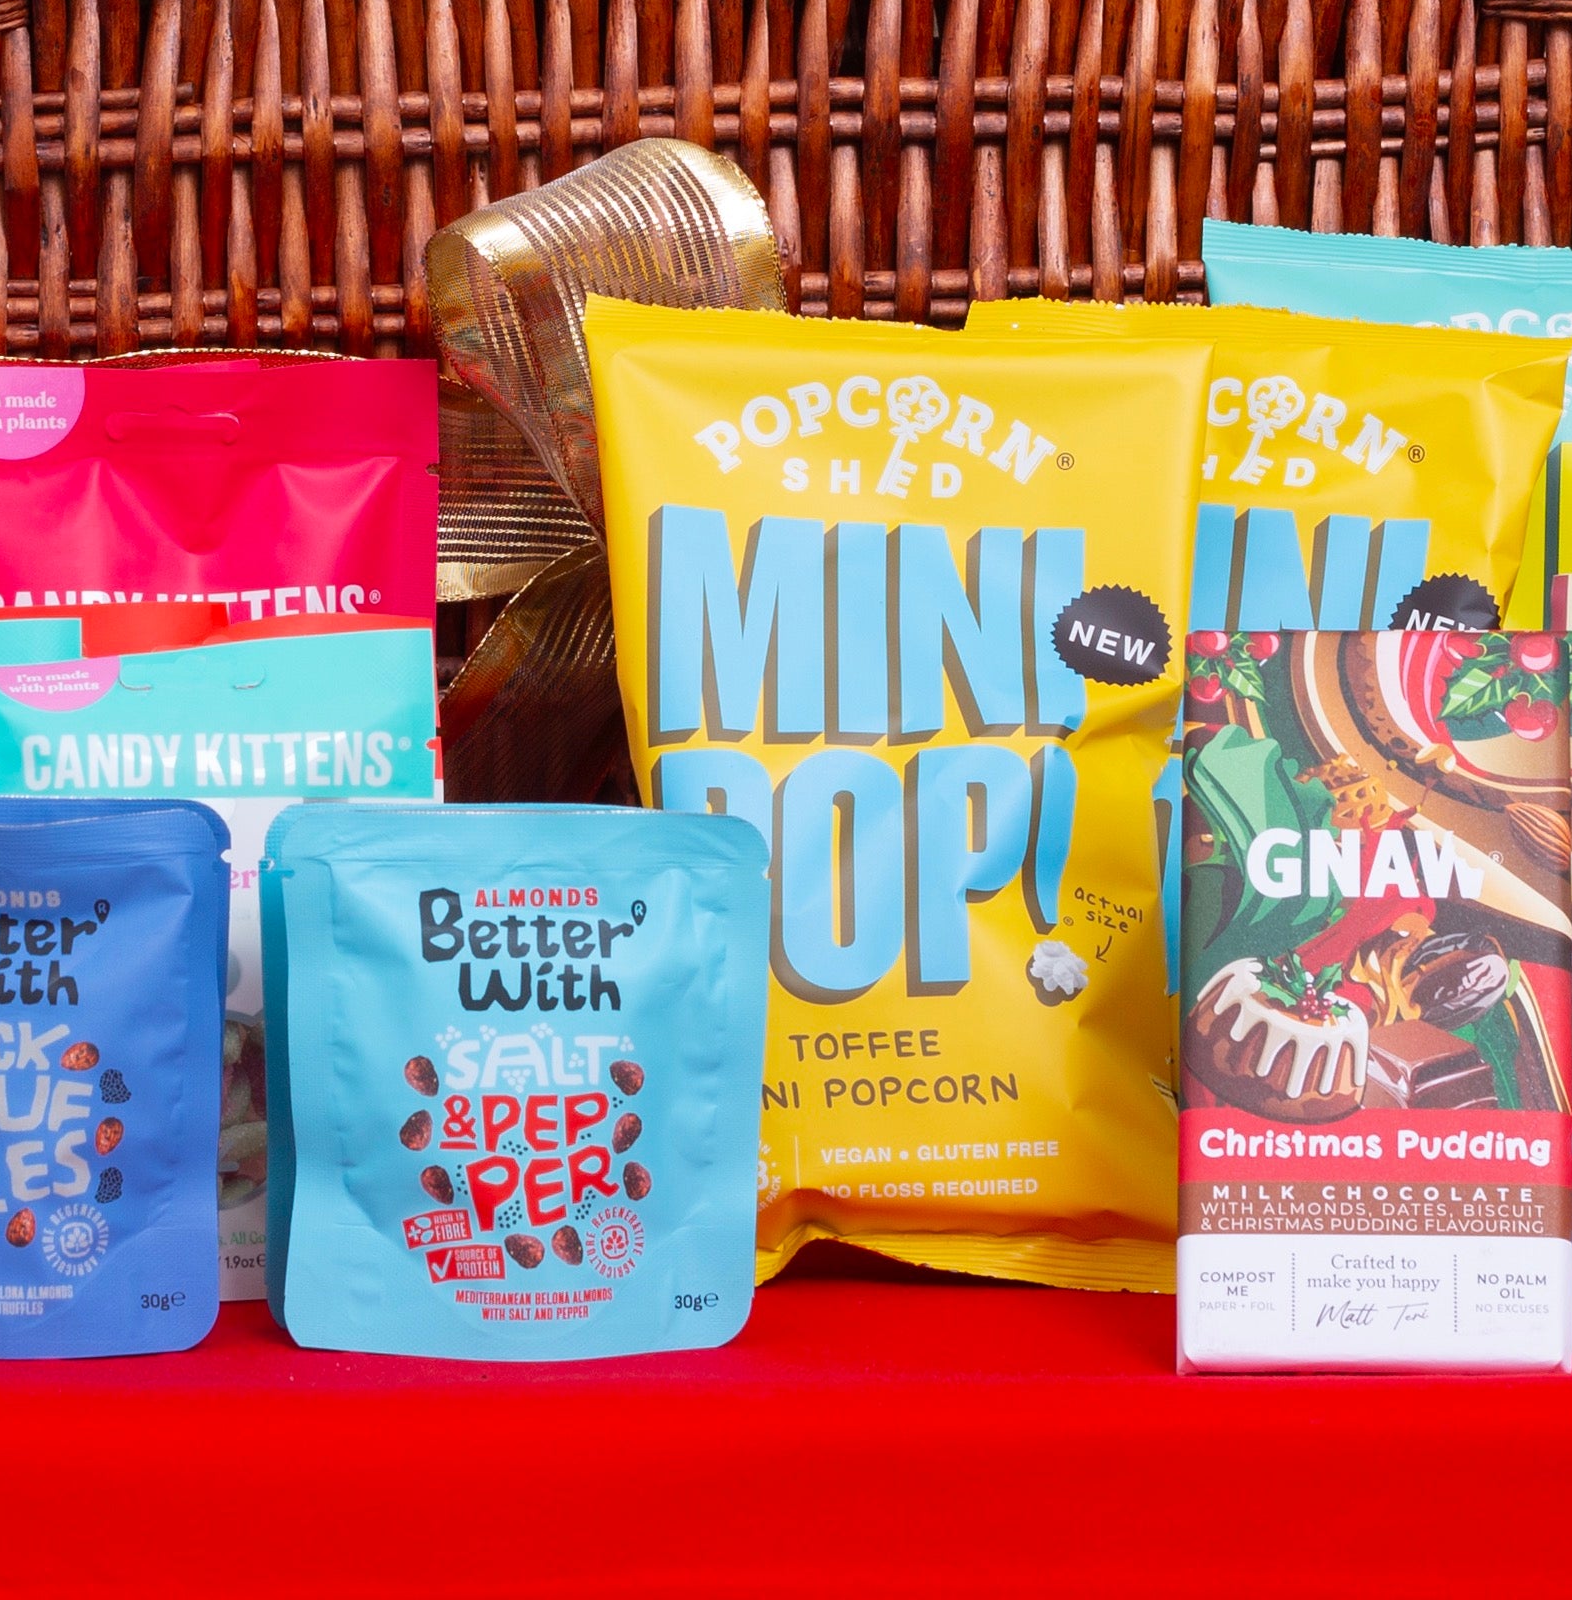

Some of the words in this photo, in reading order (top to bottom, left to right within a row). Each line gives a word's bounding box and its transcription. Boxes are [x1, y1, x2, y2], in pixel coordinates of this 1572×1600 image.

[4, 390, 58, 410] made
[6, 411, 69, 434] plants
[693, 373, 1057, 485] POPCORN
[780, 456, 964, 501] SHED
[649, 502, 1089, 746] MINI
[1067, 614, 1159, 668] NEW
[21, 731, 187, 791] CANDY
[193, 728, 396, 790] KITTENS
[1245, 828, 1485, 900] GNAW
[474, 887, 600, 909] ALMONDS
[1073, 886, 1145, 925] actual
[417, 886, 632, 965] Better
[1085, 908, 1130, 935] size
[457, 961, 624, 1013] With
[787, 1028, 943, 1064] TOFFEE
[441, 1030, 620, 1092] SALT
[823, 1071, 1020, 1110] POPCORN
[438, 1092, 478, 1152] &
[481, 1090, 611, 1154] PEP
[820, 1146, 893, 1166] VEGAN
[915, 1141, 1000, 1163] GLUTEN
[1005, 1139, 1061, 1158] FREE
[1198, 1126, 1384, 1160] Christmas
[1396, 1129, 1553, 1168] Pudding
[464, 1143, 620, 1233] PER
[857, 1182, 927, 1199] FLOSS
[931, 1177, 1040, 1198] REQUIRED
[1212, 1184, 1297, 1201] MILK
[1321, 1184, 1535, 1204] CHOCOLATE
[1200, 1201, 1260, 1217] WITH
[1261, 1201, 1374, 1219] ALMONDS,
[1380, 1202, 1455, 1219] DATES,
[1462, 1202, 1547, 1220] BISCUIT
[434, 1222, 469, 1243] FIBRE
[1199, 1217, 1217, 1232] &
[1217, 1216, 1326, 1232] CHRISTMAS
[1329, 1217, 1419, 1233] PUDDING
[1424, 1218, 1546, 1235] FLAVOURING
[455, 1257, 502, 1278] PROTEIN
[1330, 1253, 1398, 1271] Crafted
[1400, 1255, 1419, 1272] to
[1199, 1271, 1277, 1285] COMPOST
[1306, 1274, 1352, 1290] make
[1354, 1277, 1389, 1293] you
[1390, 1273, 1442, 1293] happy
[1476, 1273, 1501, 1287] NO
[1504, 1273, 1549, 1288] PALM
[454, 1288, 534, 1306] MEDITERRANEAN
[572, 1286, 615, 1303] ALMONDS
[1226, 1285, 1251, 1298] ME
[1498, 1287, 1527, 1301] OIL
[481, 1306, 507, 1321] WITH
[508, 1306, 533, 1321] SALT
[534, 1306, 554, 1320] AND
[555, 1304, 590, 1320] PEPPER
